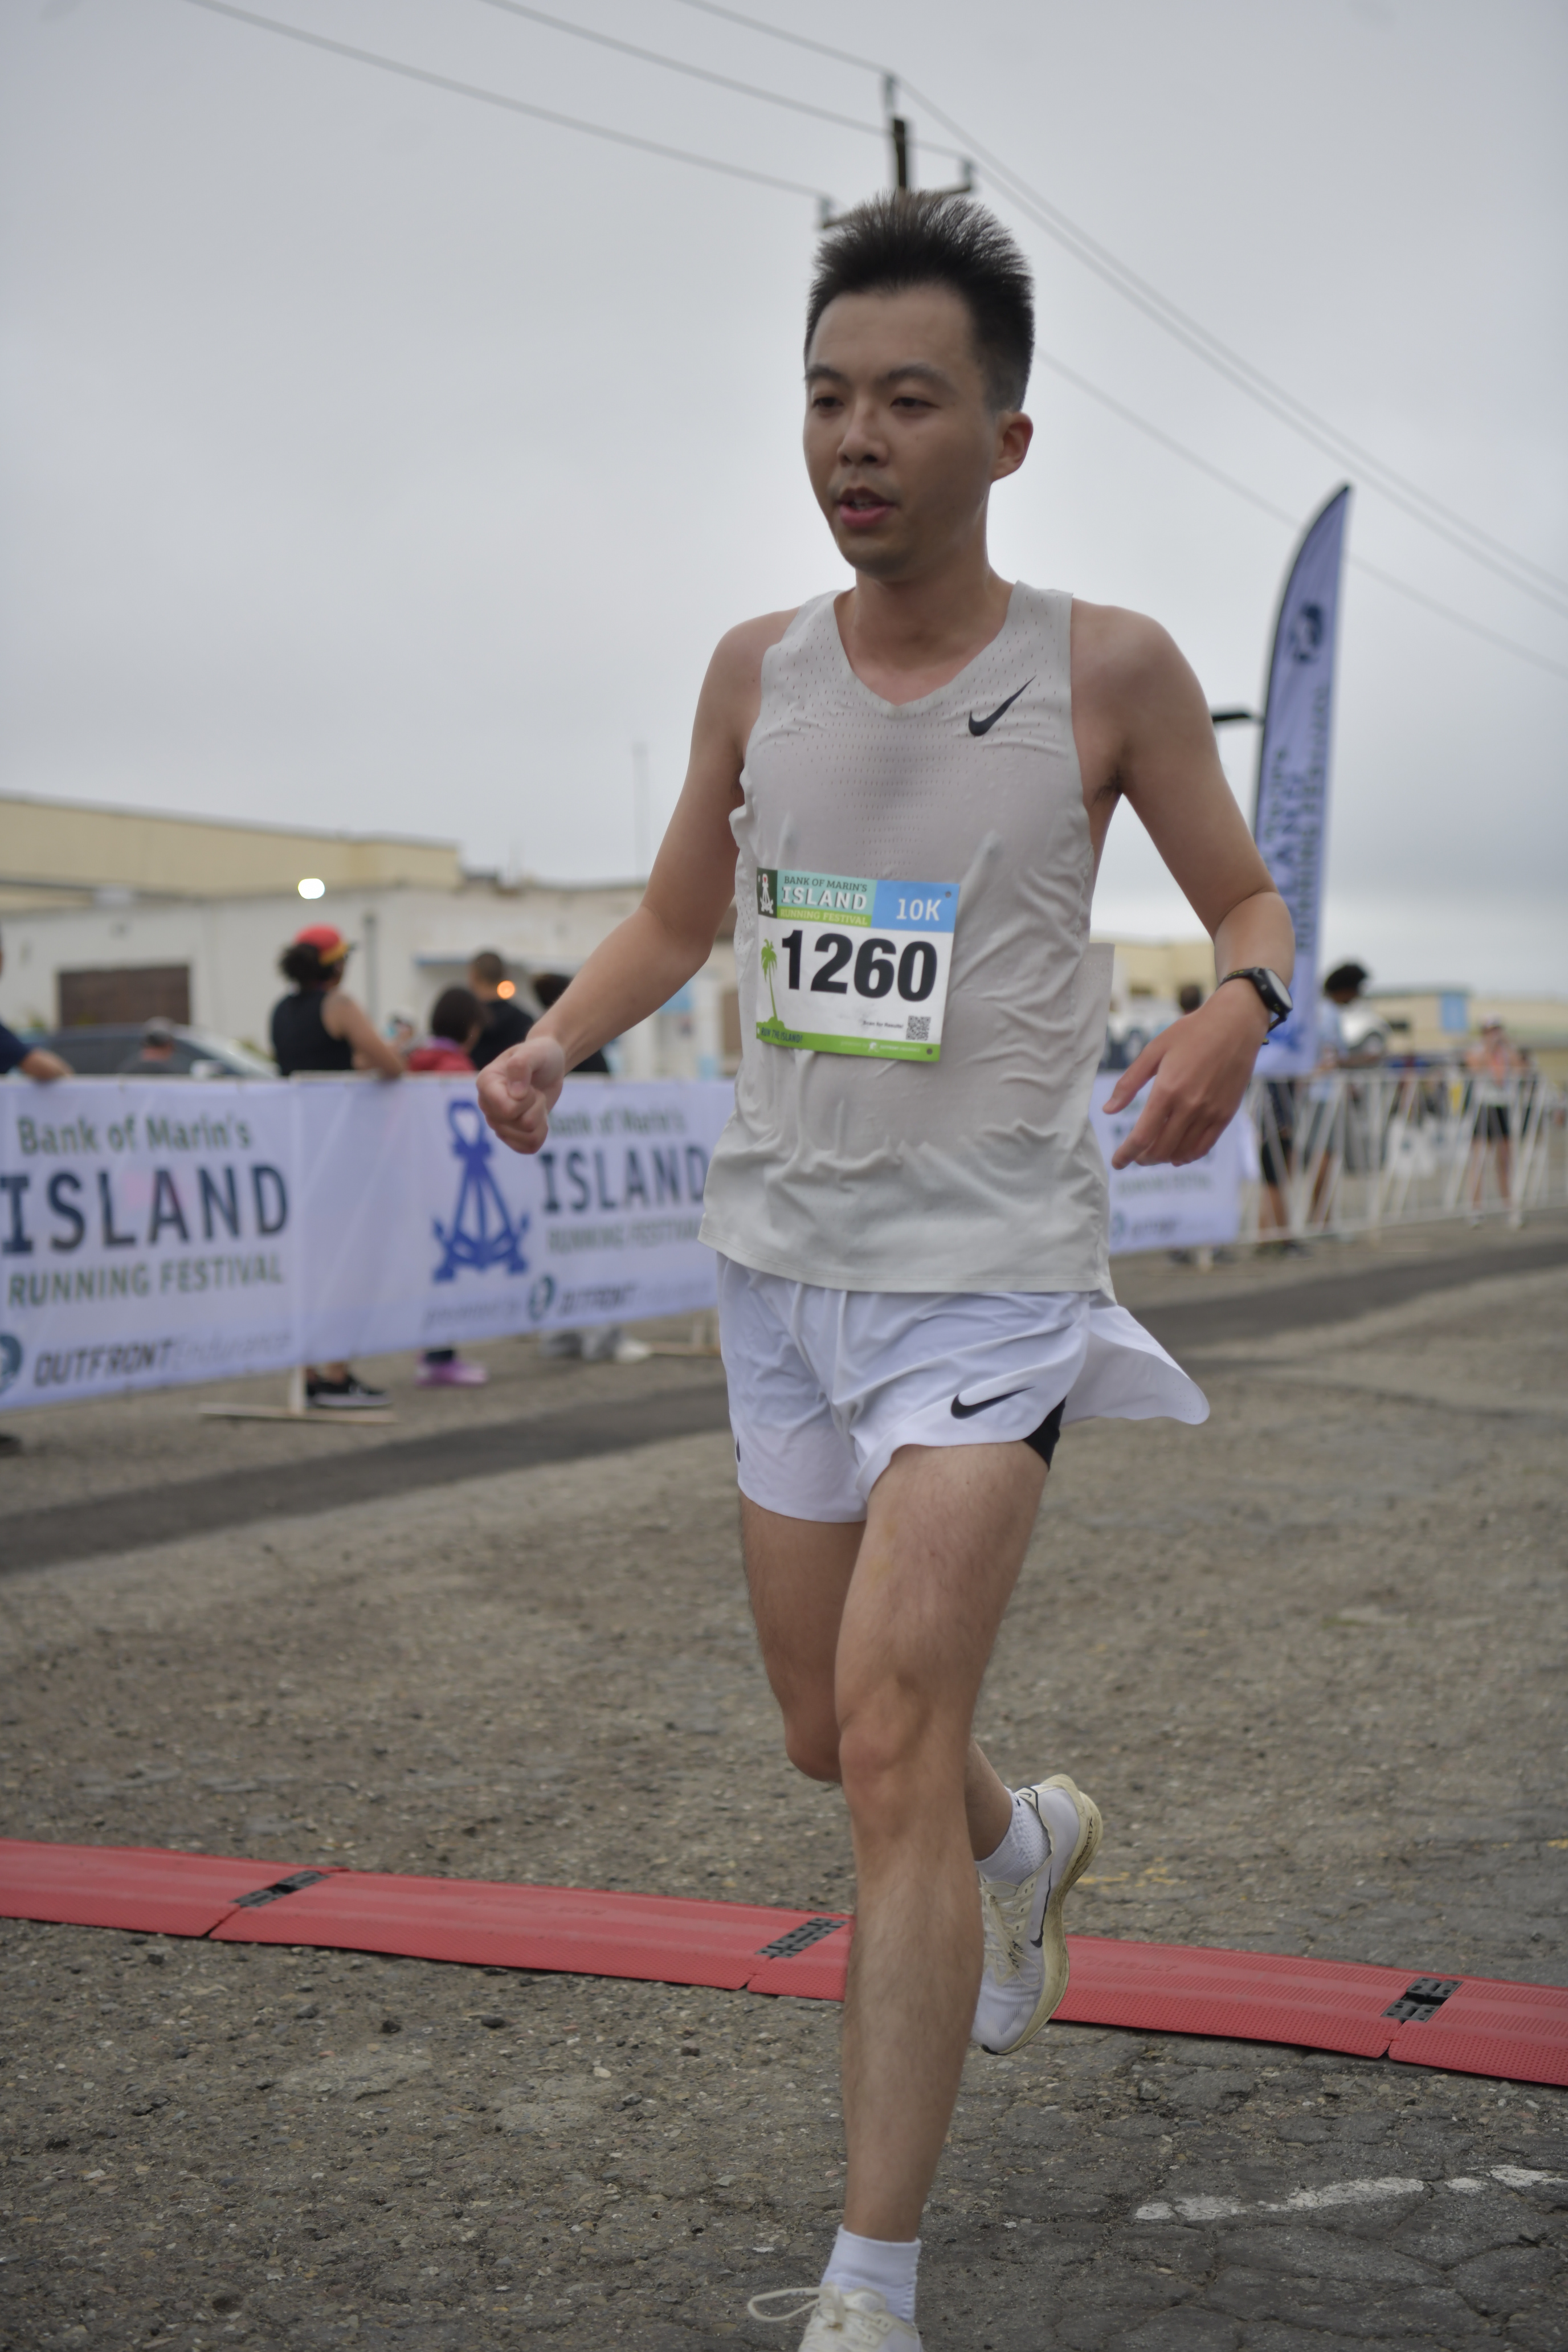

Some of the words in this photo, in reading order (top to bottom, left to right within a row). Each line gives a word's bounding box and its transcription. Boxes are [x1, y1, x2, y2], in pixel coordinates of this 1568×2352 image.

[782, 885, 867, 910] ISLAND
[784, 876, 810, 886] BANK
[812, 879, 825, 888] OF
[826, 881, 868, 893] MARIN'S
[780, 909, 820, 920] RUNNING
[823, 911, 868, 926] FESTIVAL
[896, 898, 941, 921] 10K
[782, 930, 938, 1002] 1260
[761, 1027, 771, 1036] RUN
[781, 1031, 803, 1043] ISLAND!
[17, 1115, 96, 1155] Bank
[107, 1110, 137, 1152] of
[146, 1110, 252, 1152] Marin's
[539, 1144, 710, 1214] ISLAND
[0, 1163, 289, 1255] ISLAND
[8, 1261, 150, 1308] RUNNING
[160, 1251, 284, 1296] FESTIVAL
[34, 1337, 174, 1388] OUTFRONT
